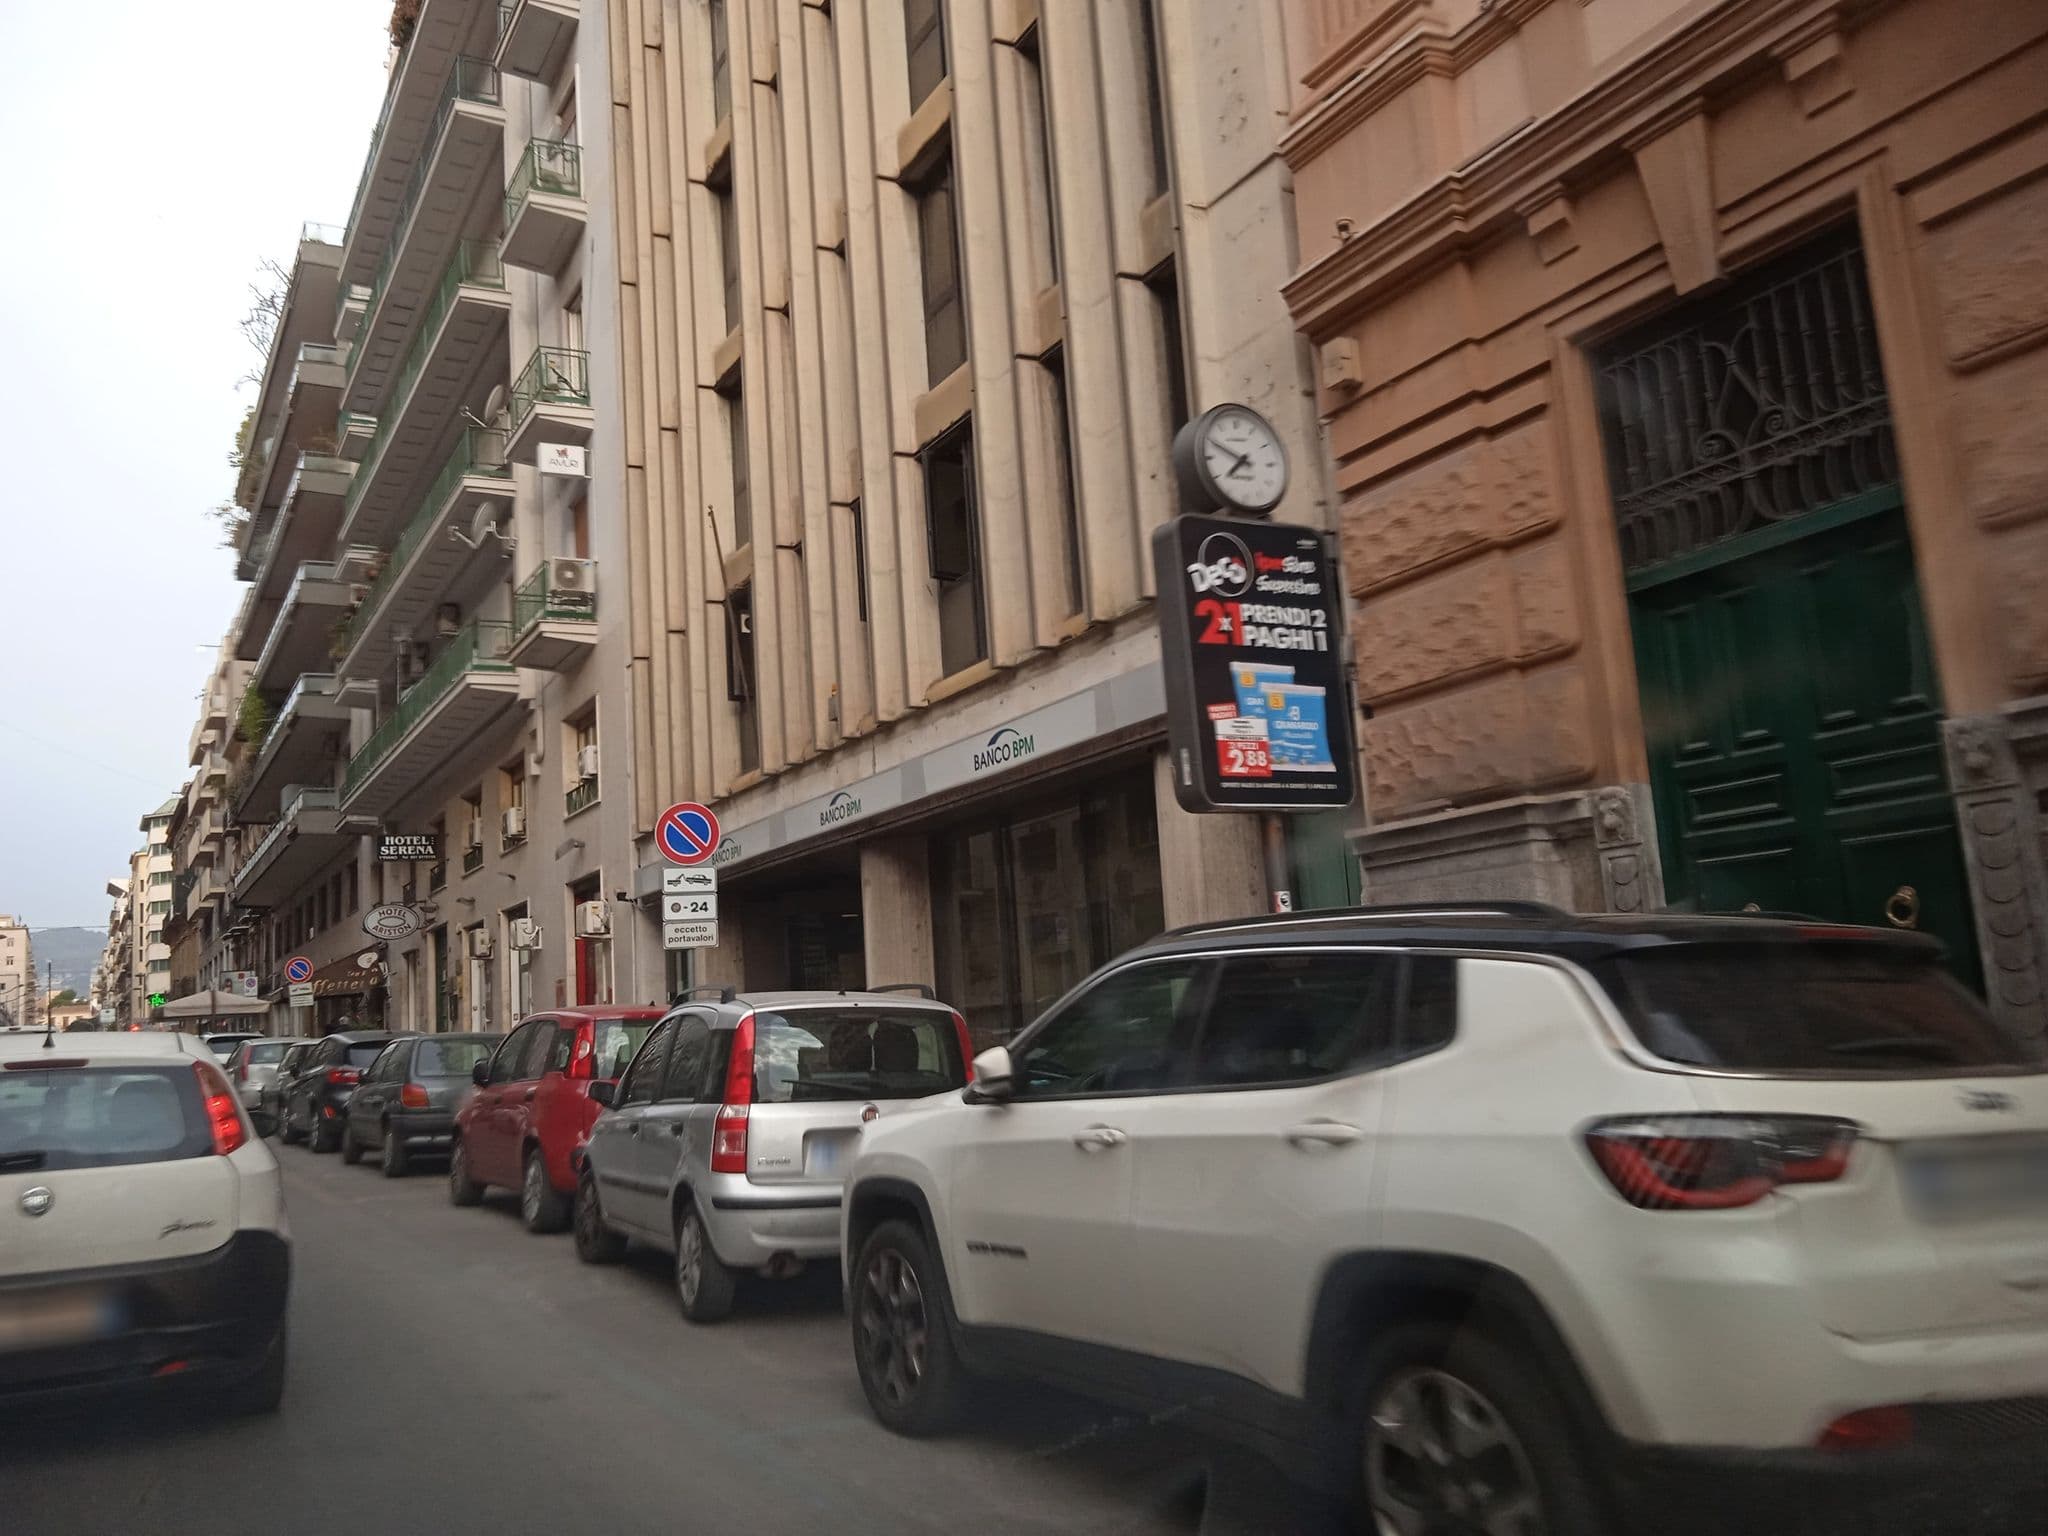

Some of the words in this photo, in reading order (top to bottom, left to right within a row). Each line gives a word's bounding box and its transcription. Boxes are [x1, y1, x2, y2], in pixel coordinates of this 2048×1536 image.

[1240, 603, 1311, 627] PRENDI
[1311, 609, 1327, 627] 2
[1241, 625, 1315, 650] PAGHI
[974, 743, 1011, 771] BANCO
[1012, 734, 1035, 758] BPM
[820, 804, 845, 826] BANCO
[846, 798, 862, 817] BPM
[385, 836, 430, 845] HOTEL
[380, 846, 434, 855] SERENA
[378, 908, 407, 918] HOTEL
[371, 923, 412, 936] ARISTON
[674, 925, 708, 934] eccetto
[668, 934, 714, 944] portavalori
